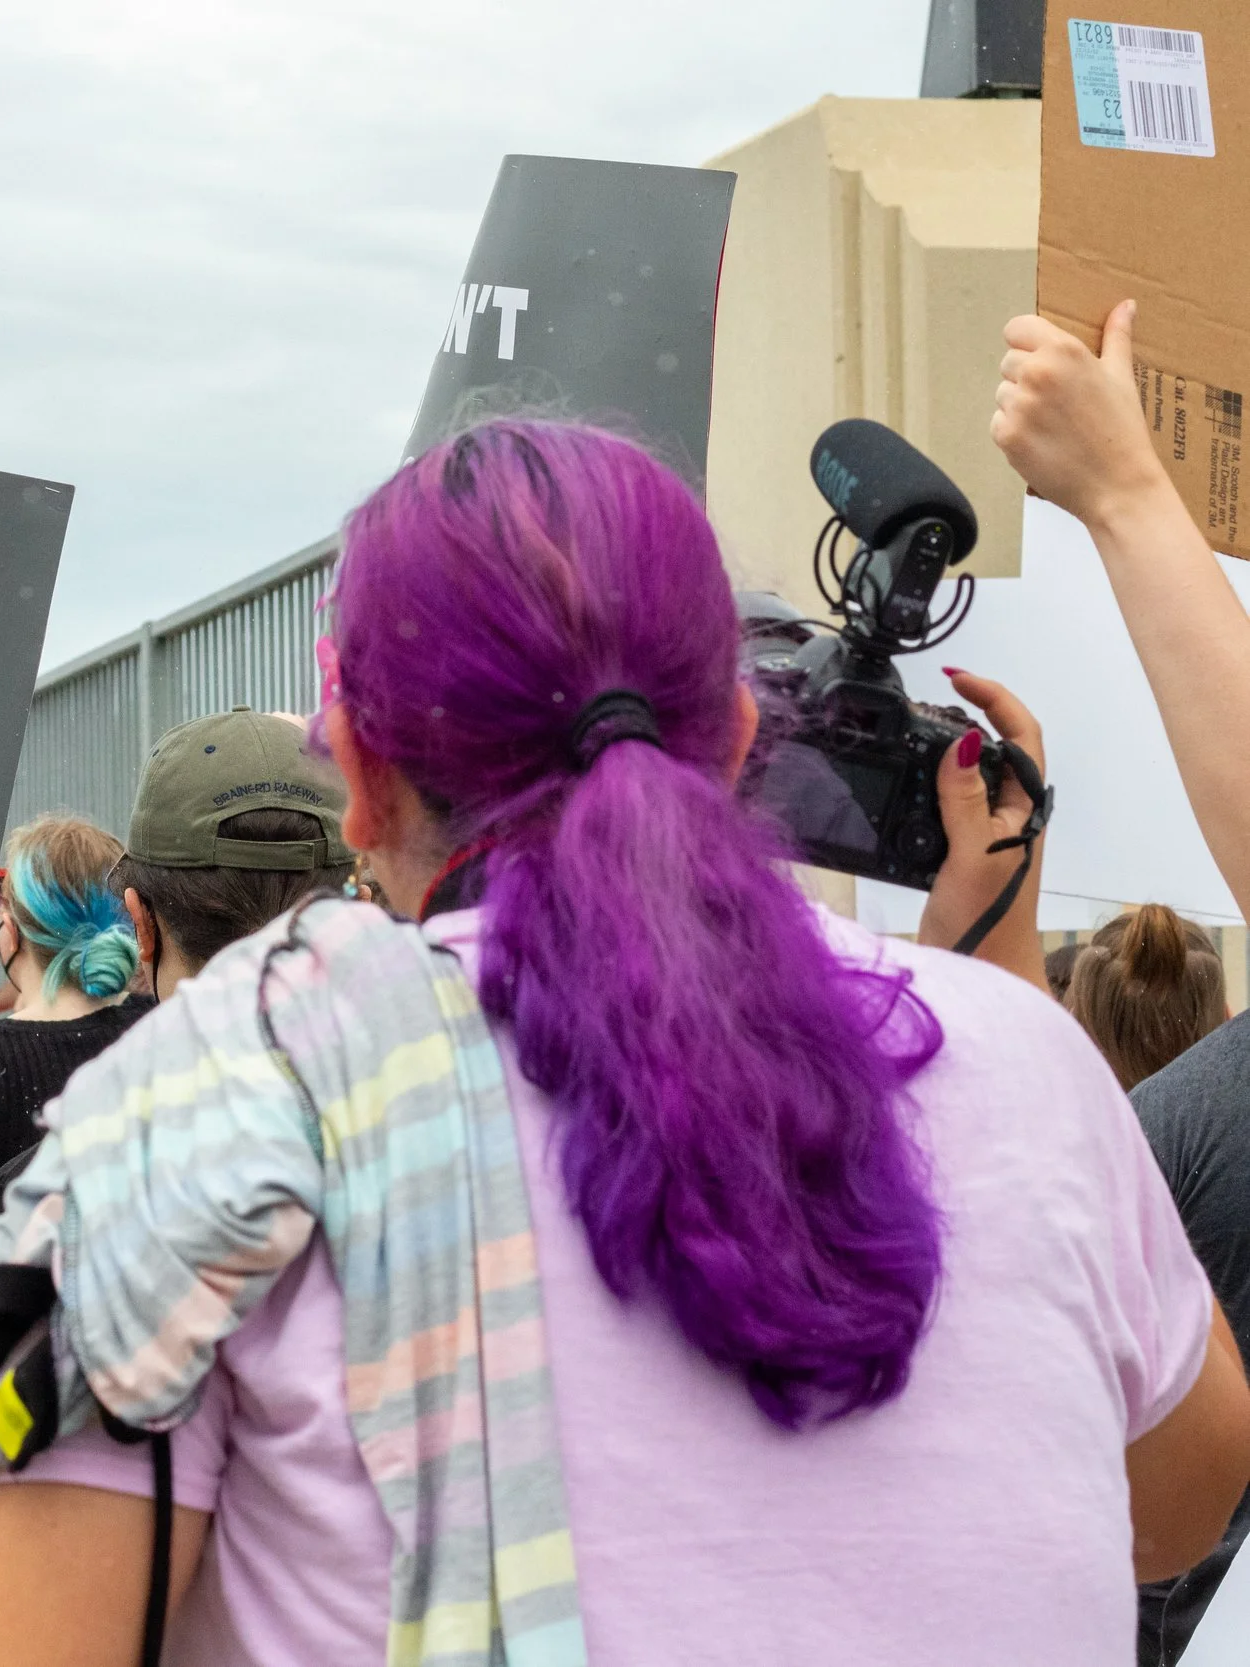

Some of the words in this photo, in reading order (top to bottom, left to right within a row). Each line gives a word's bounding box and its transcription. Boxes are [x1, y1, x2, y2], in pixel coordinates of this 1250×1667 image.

[1074, 21, 1113, 44] 6821
[1174, 376, 1186, 404] Cat.
[1153, 397, 1164, 432] Pending
[1174, 407, 1186, 461] 8022FB
[1209, 438, 1219, 495] trademarks
[1221, 440, 1231, 467] Plaid
[1218, 469, 1229, 505] Design
[1229, 466, 1240, 501] Scotch
[1208, 497, 1217, 509] of
[1218, 507, 1226, 525] are
[1229, 503, 1238, 524] and
[1228, 526, 1237, 542] the
[212, 782, 271, 807] BRAINERD
[273, 782, 323, 805] RACEWAY
